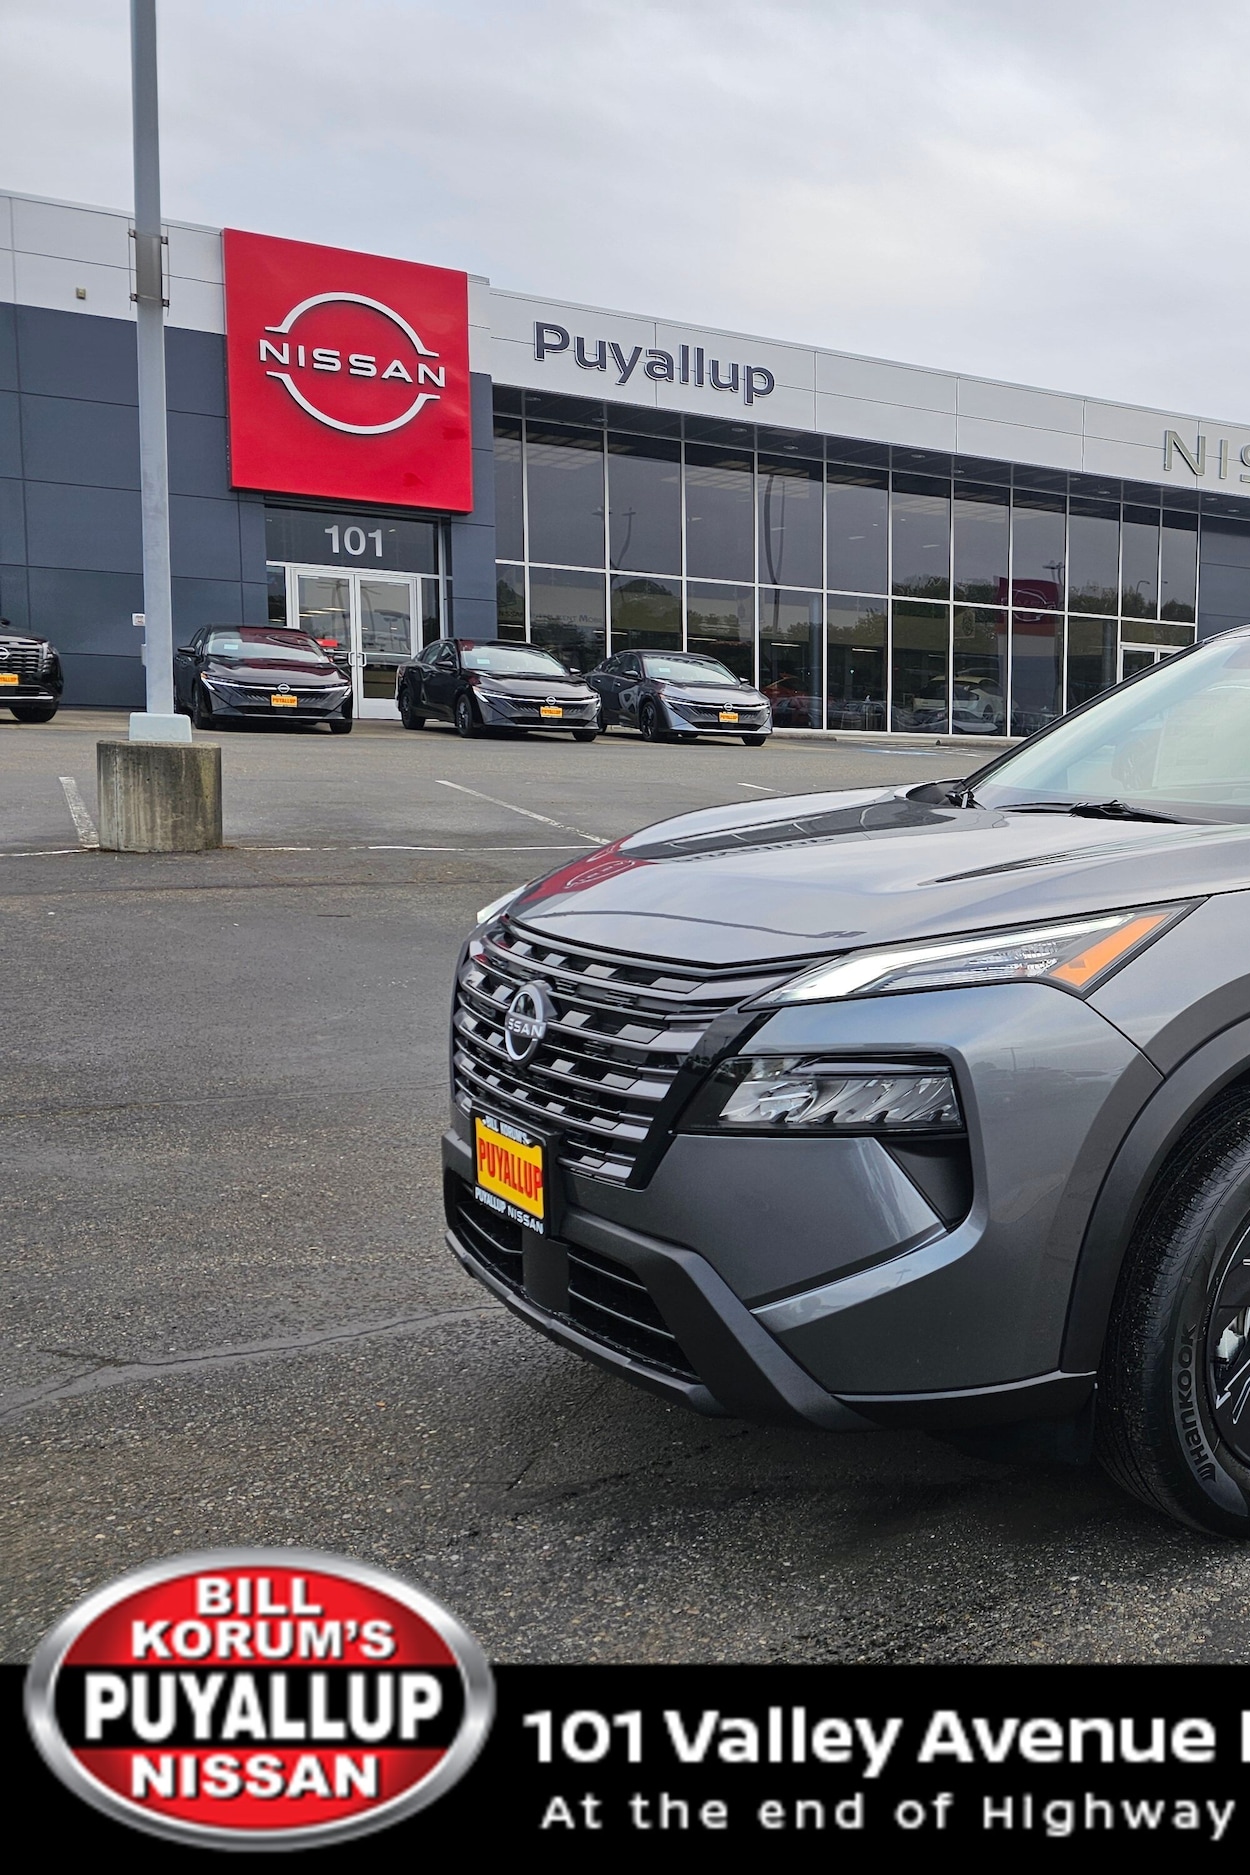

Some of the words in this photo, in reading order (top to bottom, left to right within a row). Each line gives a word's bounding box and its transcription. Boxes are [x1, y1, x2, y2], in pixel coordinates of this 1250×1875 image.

[259, 338, 446, 388] NISSAN
[534, 320, 776, 406] Puyallup
[324, 525, 383, 557] 101
[508, 1018, 546, 1038] SSAN
[478, 1137, 543, 1202] PUYALLUP
[475, 1187, 506, 1214] PUYALLUP
[507, 1205, 544, 1235] NISSAN
